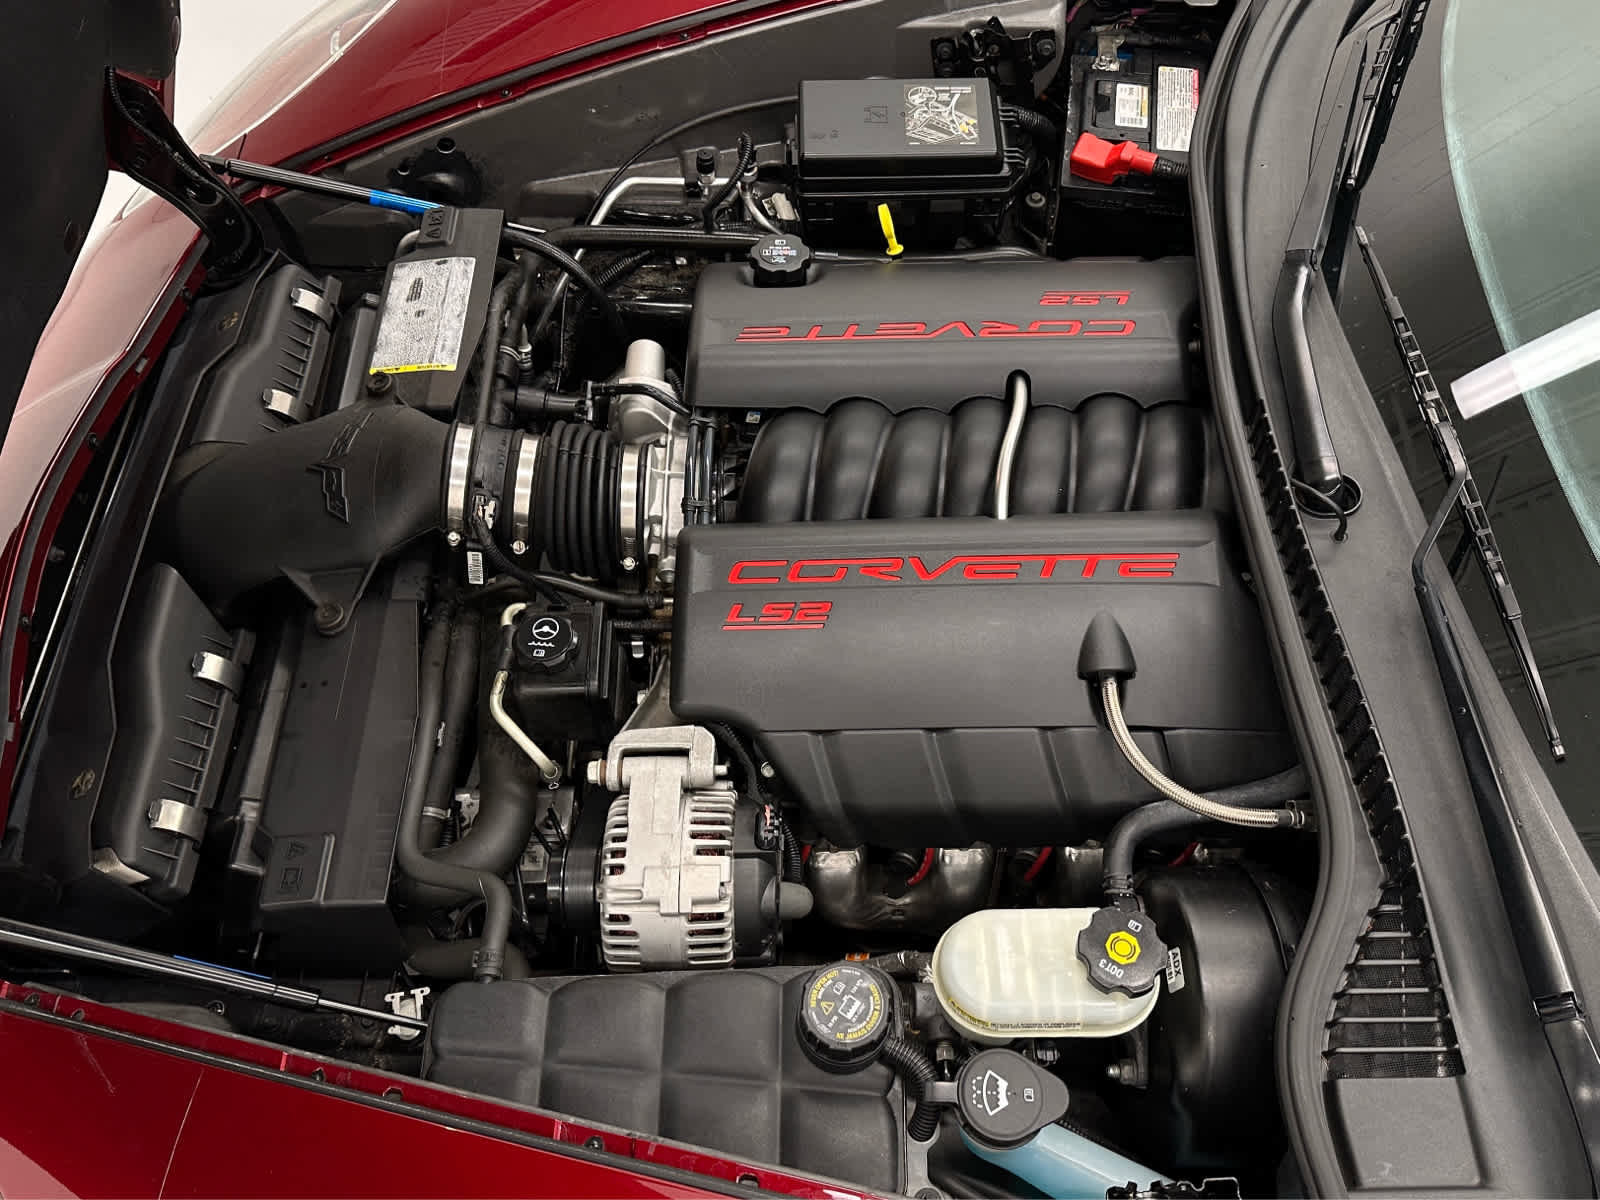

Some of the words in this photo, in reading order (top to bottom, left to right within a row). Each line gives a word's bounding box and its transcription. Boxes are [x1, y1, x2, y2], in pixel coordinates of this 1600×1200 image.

[1040, 292, 1131, 305] LS2
[736, 319, 1136, 342] CORVETTE
[728, 553, 1180, 584] CORVETTE
[725, 602, 832, 627] LS2
[1172, 952, 1182, 977] ADX
